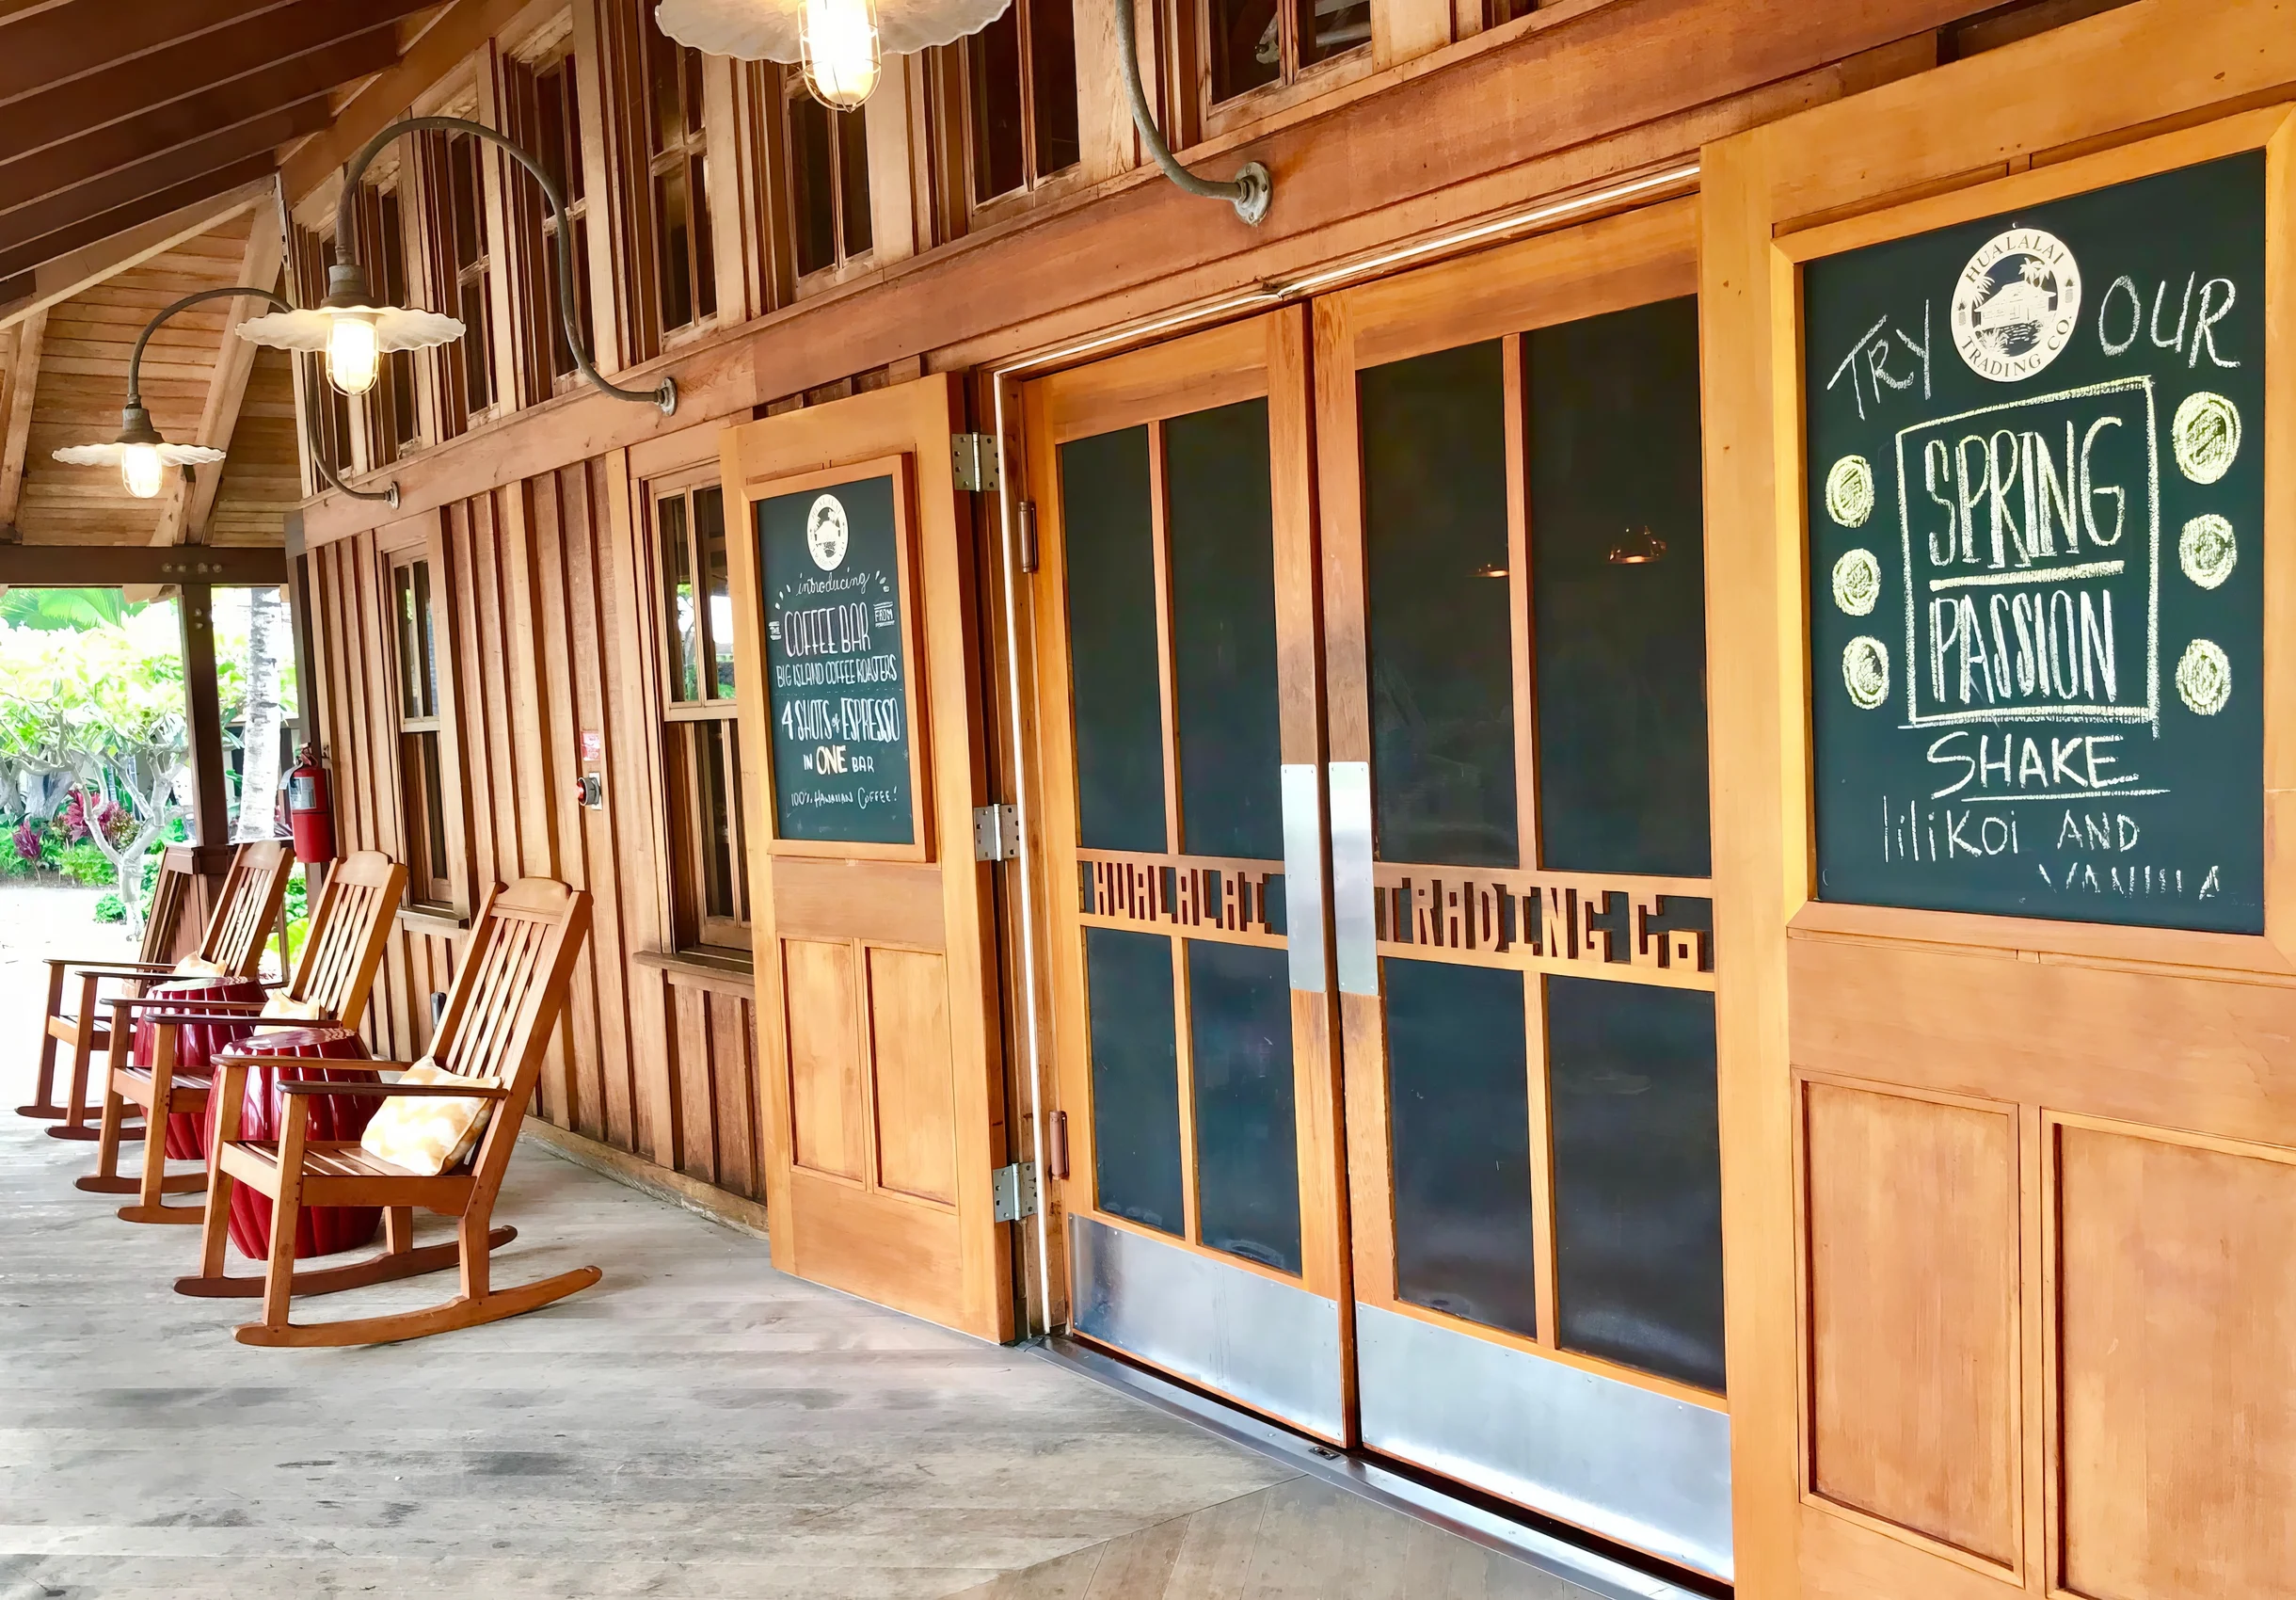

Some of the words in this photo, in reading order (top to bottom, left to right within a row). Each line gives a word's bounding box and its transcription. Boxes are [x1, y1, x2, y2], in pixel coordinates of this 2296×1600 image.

[1966, 234, 2065, 284] HUALALAI
[1826, 298, 1932, 421] TRY
[2097, 271, 2241, 368] OUR
[1961, 335, 2042, 377] TRADING
[2047, 315, 2073, 351] CO.
[1924, 415, 2126, 569] SPRING
[796, 567, 870, 596] introducing
[784, 607, 837, 657] COFFEE
[839, 602, 871, 652] BAR
[1929, 589, 2117, 704] PASSION
[776, 664, 792, 688] BIG
[792, 662, 824, 687] ISLAND
[825, 660, 855, 685] COFFEE
[856, 653, 897, 683] ROASTERS
[781, 700, 793, 741] 4
[794, 699, 833, 741] SHOTS
[840, 696, 901, 743] ESPRESSO
[803, 753, 813, 770] IN
[816, 744, 848, 775] ONE
[851, 756, 874, 773] BAR
[1926, 730, 2140, 800] SHAKE
[2057, 809, 2140, 852] AND
[1374, 876, 1605, 962] TRADING
